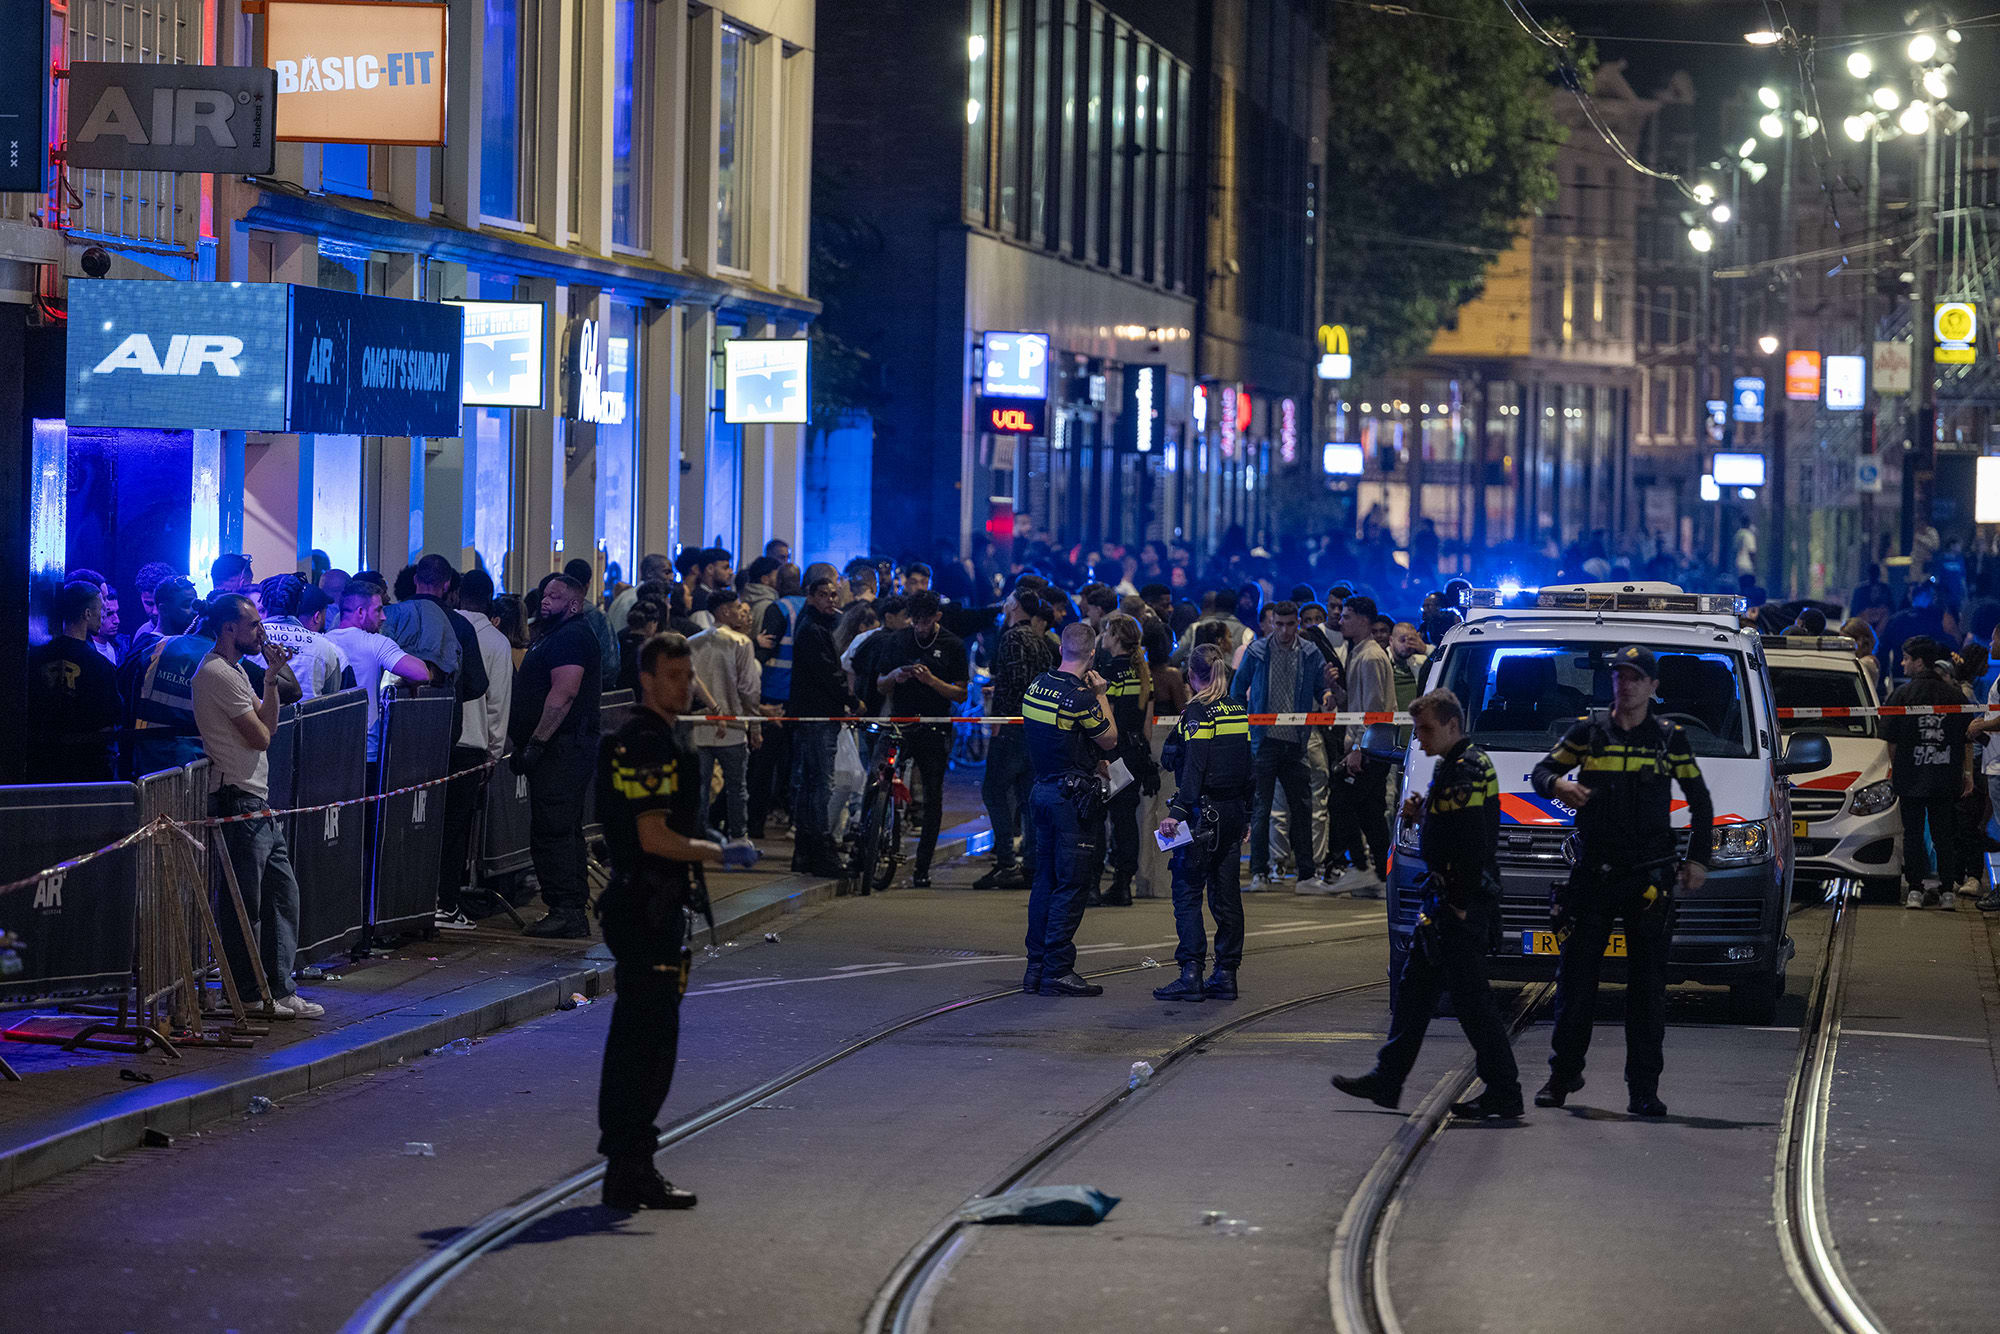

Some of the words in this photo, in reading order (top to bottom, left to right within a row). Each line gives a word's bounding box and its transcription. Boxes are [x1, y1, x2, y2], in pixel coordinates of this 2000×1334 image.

[276, 51, 435, 94] BASIC-FIT
[93, 333, 244, 377] AIR
[306, 336, 334, 385] AIR
[992, 409, 1034, 431] VOL
[265, 624, 316, 635] EVELAN
[33, 873, 64, 909] AIR
